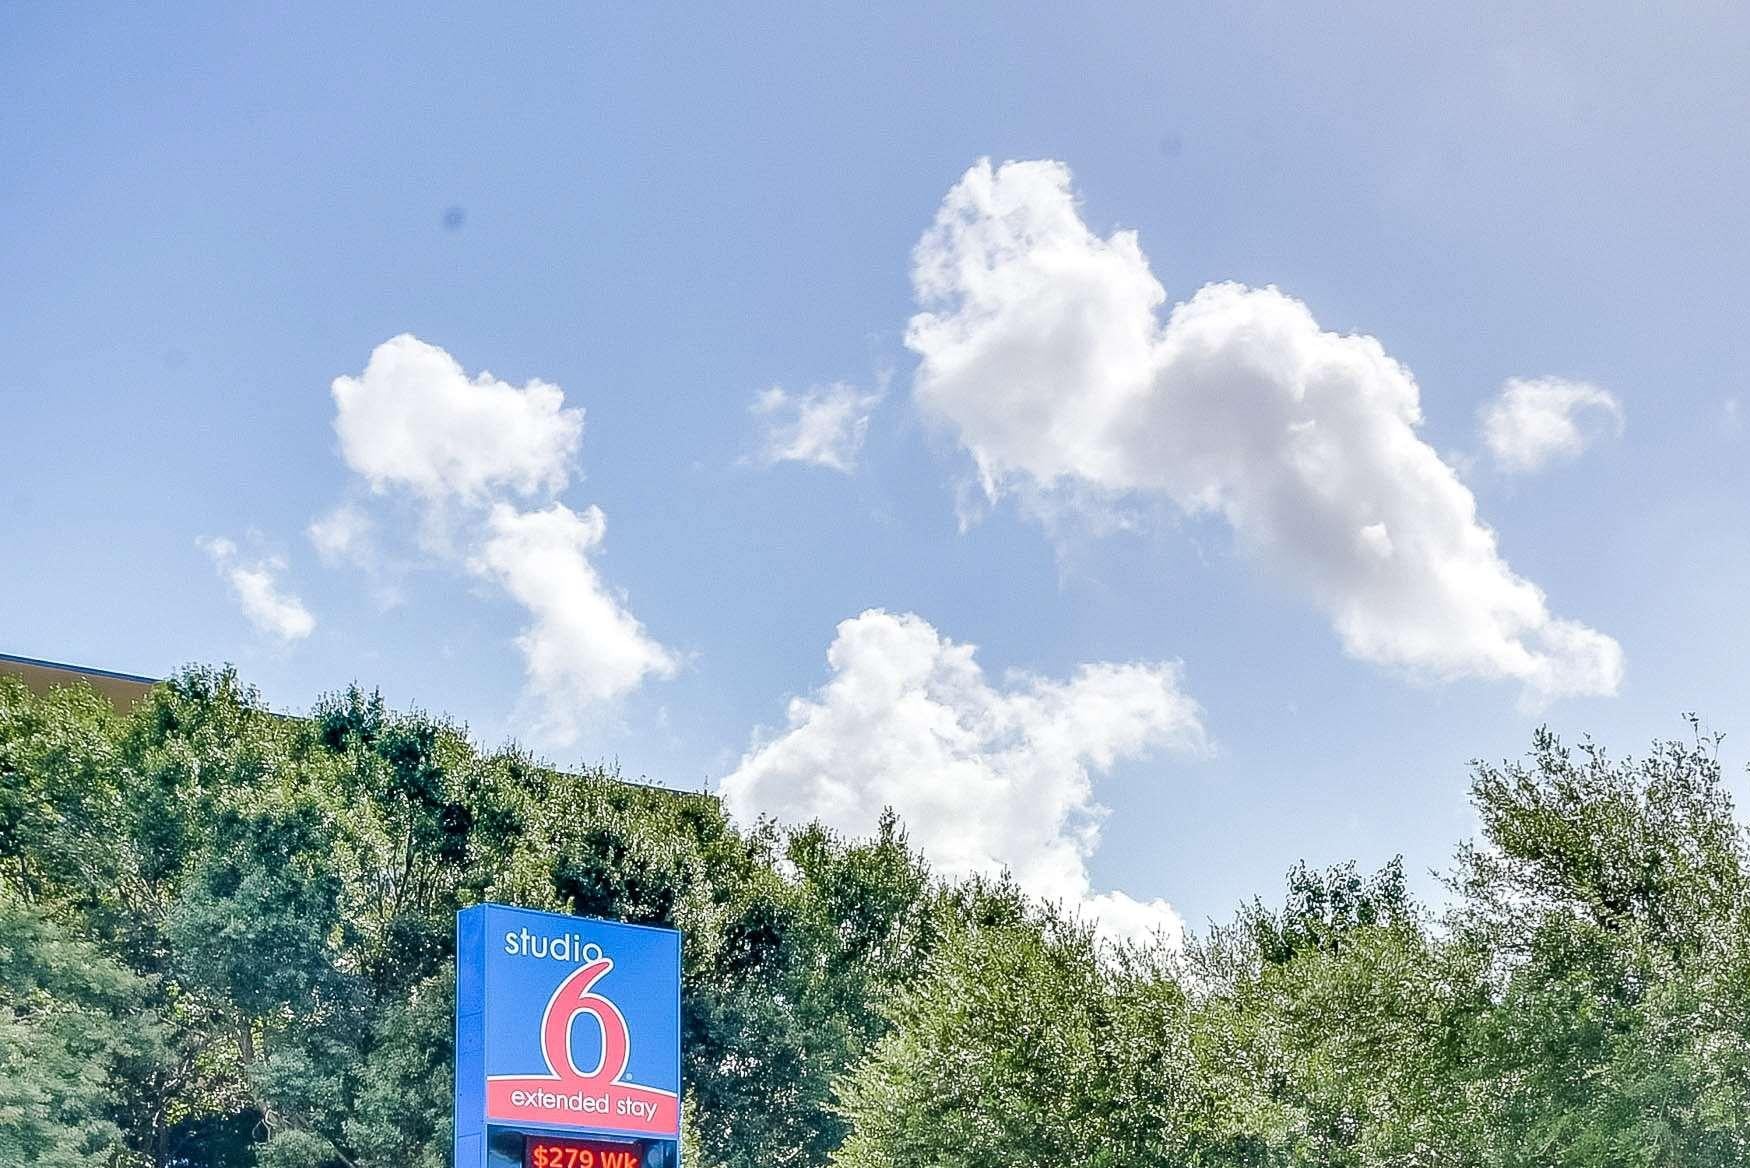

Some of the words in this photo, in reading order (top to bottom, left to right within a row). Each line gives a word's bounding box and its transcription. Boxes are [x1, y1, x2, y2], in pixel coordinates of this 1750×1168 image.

[504, 927, 603, 963] studio
[540, 957, 630, 1080] 6
[511, 1088, 609, 1114] extended
[616, 1096, 658, 1121] stay
